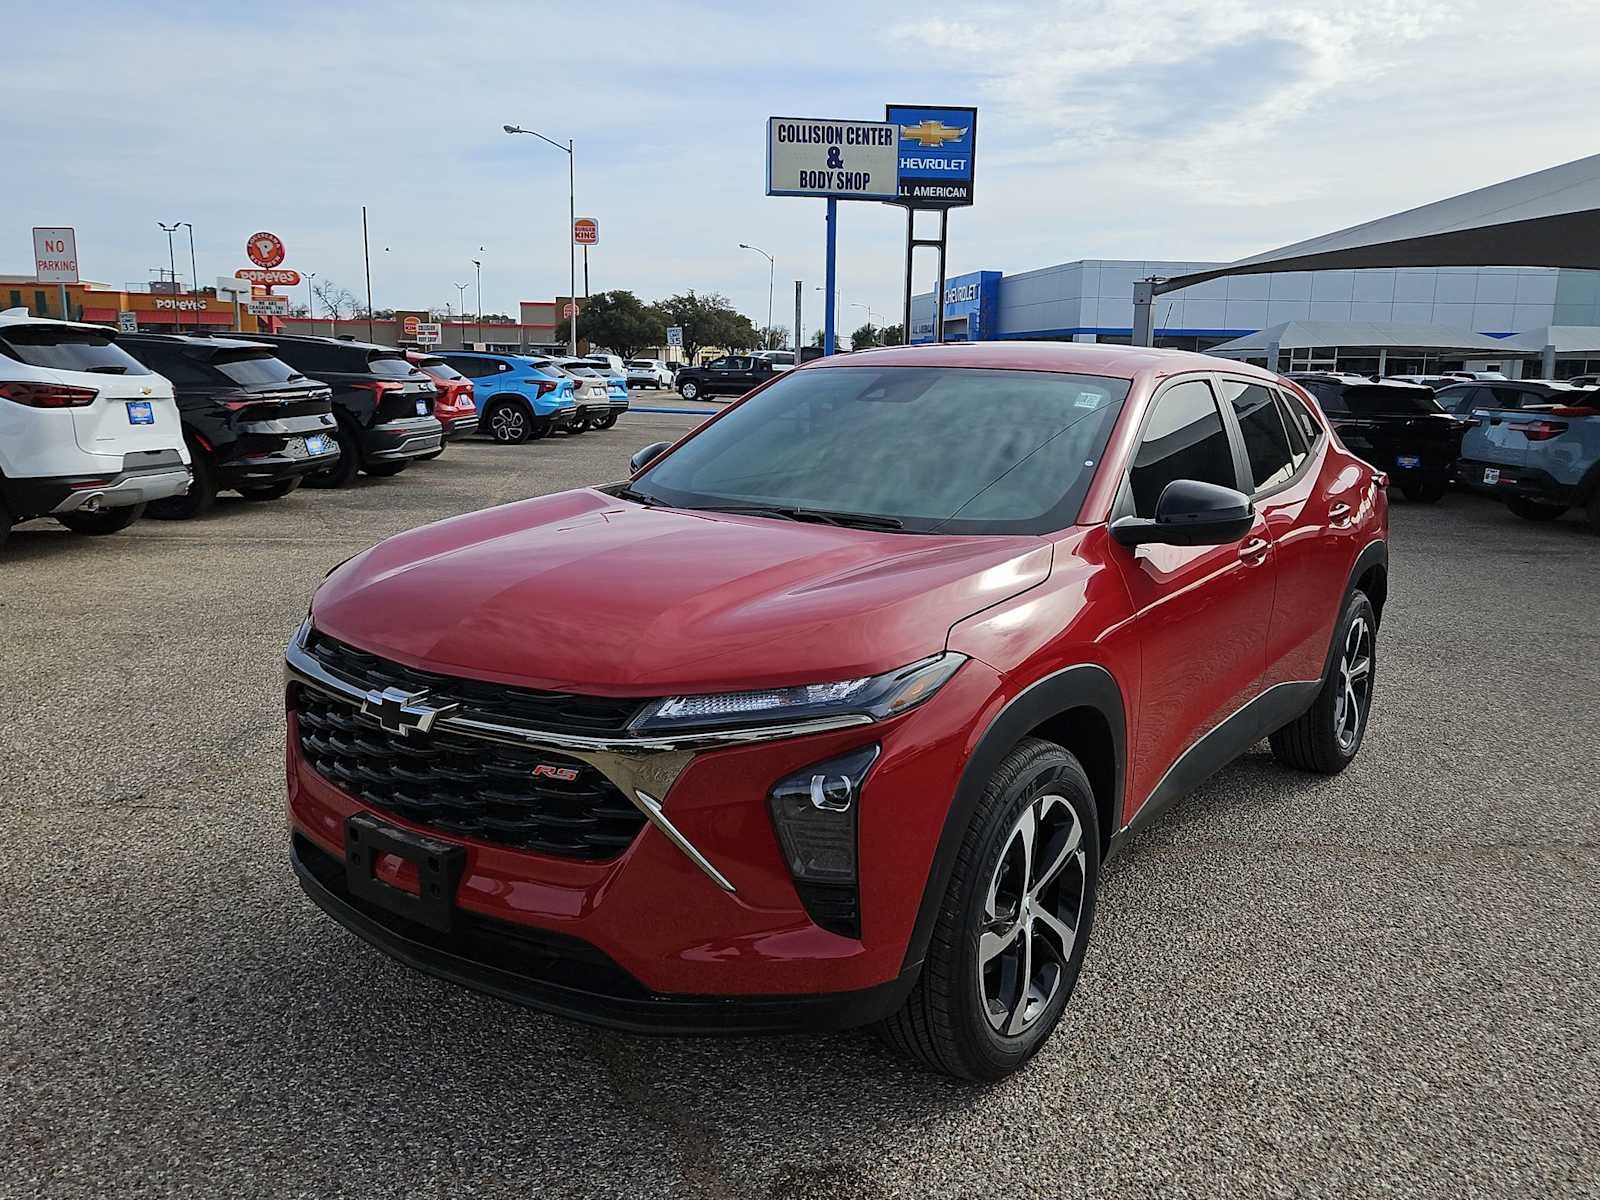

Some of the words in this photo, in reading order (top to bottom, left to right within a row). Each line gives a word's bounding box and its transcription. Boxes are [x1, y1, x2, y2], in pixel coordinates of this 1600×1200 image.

[778, 124, 843, 145] COLLISION
[847, 126, 893, 146] CENTER
[826, 146, 844, 169] &
[899, 157, 967, 171] HEVROLET
[800, 170, 834, 189] BODY
[837, 171, 870, 191] SHOP
[913, 186, 967, 198] AMERICAN
[45, 239, 65, 253] NO
[38, 260, 76, 271] PARKING
[122, 323, 136, 332] 35
[669, 337, 681, 345] 35
[531, 764, 579, 781] RS
